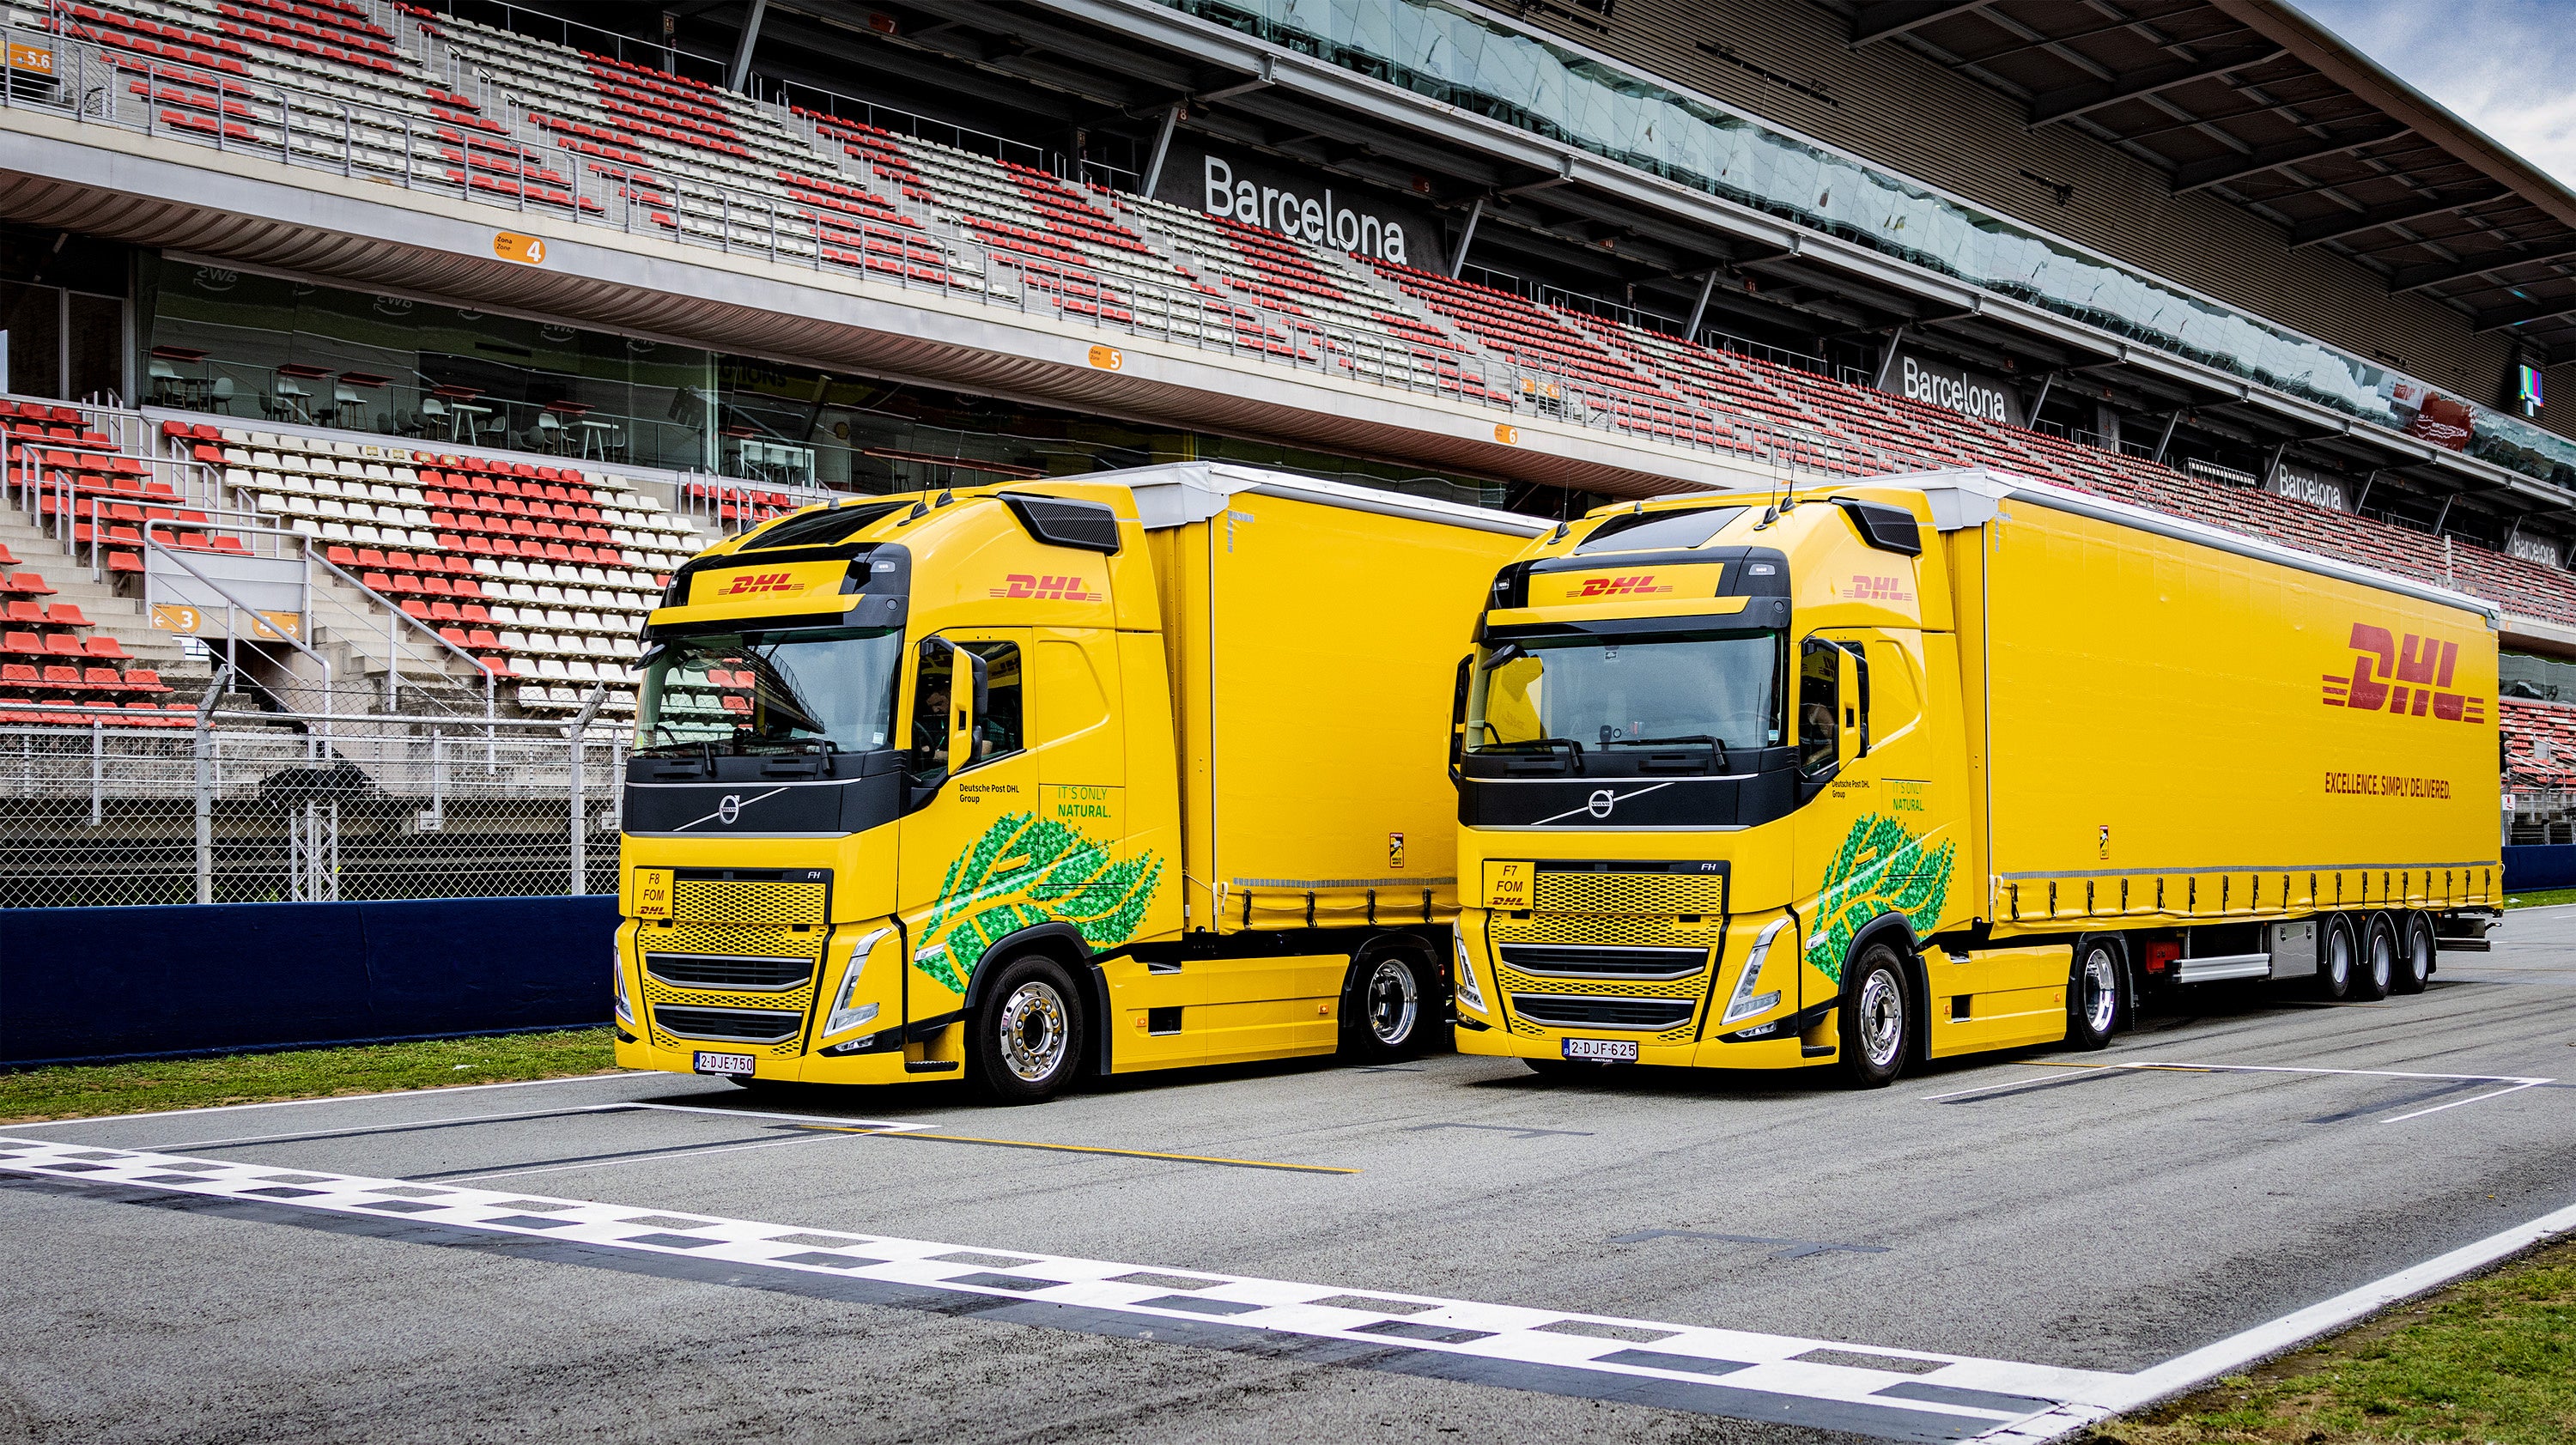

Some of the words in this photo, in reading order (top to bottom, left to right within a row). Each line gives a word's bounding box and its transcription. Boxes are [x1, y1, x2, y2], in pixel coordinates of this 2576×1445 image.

[889, 20, 896, 33] 7
[27, 51, 51, 69] 5.6
[1180, 108, 1187, 120] 8
[1424, 181, 1430, 193] 9
[1205, 155, 1407, 265] Barcelona
[497, 235, 513, 245] Zona
[496, 243, 511, 252] Zone
[526, 240, 542, 262] 4
[1110, 351, 1121, 369] 5
[1904, 356, 2006, 423] Barcelona
[1509, 428, 1516, 444] 6
[2279, 464, 2342, 511] Barcelona
[2514, 531, 2557, 568] Barcelona
[729, 573, 791, 595] DHL
[1005, 574, 1088, 601] DHL
[1580, 575, 1656, 597] DHL
[1852, 574, 1904, 601] DHL
[181, 610, 193, 628] 3
[2347, 622, 2466, 722] DHL
[959, 783, 990, 792] Deutsche
[991, 784, 1005, 792] Post
[1006, 785, 1020, 793] DHL
[1832, 780, 1851, 788] Deutsche
[1906, 781, 1923, 794] ONLY
[2324, 772, 2379, 796] EXCELLENCE.
[2381, 775, 2409, 798] SIMPLY
[2411, 778, 2451, 800] DELIVERED.
[959, 794, 980, 804] Group
[1058, 786, 1078, 799] IT'S
[1079, 786, 1108, 800] ONLY
[1832, 790, 1846, 799] Group
[1058, 804, 1112, 818] NATURAL.
[1893, 798, 1925, 811] NATURAL.
[648, 872, 660, 884] F8
[1503, 865, 1518, 877] F7
[1496, 880, 1523, 892] FOM
[643, 889, 665, 901] FOM
[1492, 896, 1524, 906] DHL
[640, 906, 665, 915] DHL
[1571, 1041, 1636, 1057] 2-DJF-625
[701, 1055, 753, 1072] 2-DJE-750
